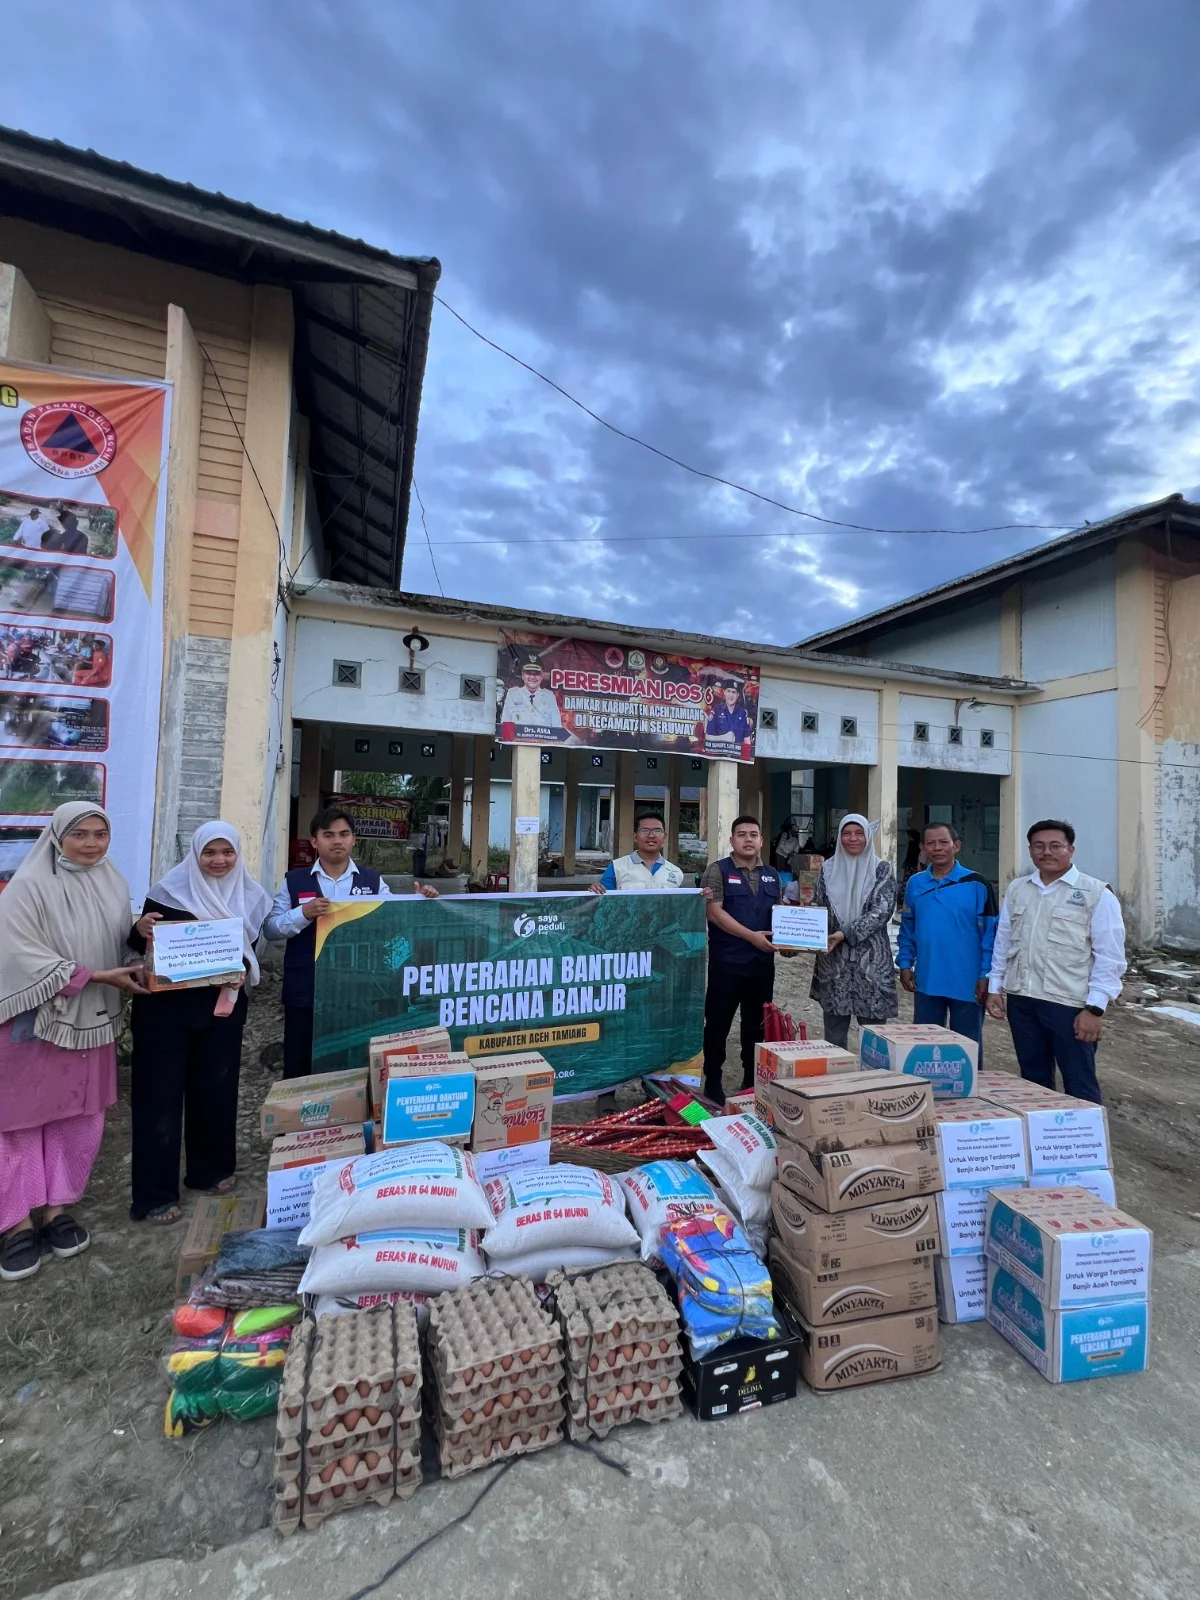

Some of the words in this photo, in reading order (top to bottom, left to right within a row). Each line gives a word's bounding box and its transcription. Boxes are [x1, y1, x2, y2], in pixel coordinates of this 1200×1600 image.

[551, 669, 662, 699] PERESMIAN
[664, 682, 702, 703] POS
[704, 686, 714, 704] 6
[564, 696, 600, 713] DAMKAR
[601, 700, 648, 717] KABUPATEN
[650, 705, 670, 719] ACEH
[575, 714, 587, 728] DI
[650, 721, 696, 736] SERUWAY
[360, 806, 407, 819] SERUWAY
[355, 820, 387, 828] AMKAR
[537, 915, 558, 923] saya
[538, 922, 566, 934] peduli
[204, 947, 240, 957] Terdampak
[402, 957, 554, 996] PENYERAHAN
[561, 951, 652, 983] BANTUAN
[439, 994, 545, 1028] BENCANA
[552, 983, 626, 1017] BANJIR
[479, 1033, 527, 1050] KABUPATEN
[528, 1031, 550, 1046] ACEH
[551, 1027, 587, 1043] TAMIANG
[868, 1092, 920, 1112] MINYAKITA
[989, 1152, 1020, 1160] Terdampak
[376, 1185, 406, 1199] BERAS
[408, 1185, 417, 1195] IR
[419, 1185, 429, 1194] 64
[430, 1185, 457, 1198] MURNI
[848, 1175, 905, 1200] MINYAKITA
[269, 1205, 290, 1214] Untuk
[293, 1202, 309, 1210] War
[870, 1204, 922, 1226] MINYAKITA
[277, 1213, 299, 1224] Banjir
[516, 1210, 541, 1227] BERAS
[543, 1210, 551, 1220] IR
[553, 1209, 563, 1218] 64
[564, 1207, 588, 1218] MURNI
[959, 1231, 976, 1239] Banjir
[375, 1250, 406, 1263] BERAS
[408, 1252, 417, 1263] IR
[418, 1254, 429, 1265] 64
[430, 1257, 458, 1272] MURNI
[1109, 1266, 1144, 1276] Terdampak
[1072, 1282, 1091, 1290] Banjir
[1110, 1279, 1137, 1287] Tamiang
[959, 1289, 976, 1297] Untuk
[357, 1293, 388, 1308] BERAS
[967, 1299, 984, 1308] Banjir
[831, 1297, 885, 1319] MINYAKITA
[835, 1356, 899, 1384] MINYAKITA
[738, 1384, 763, 1397] DELIMA
